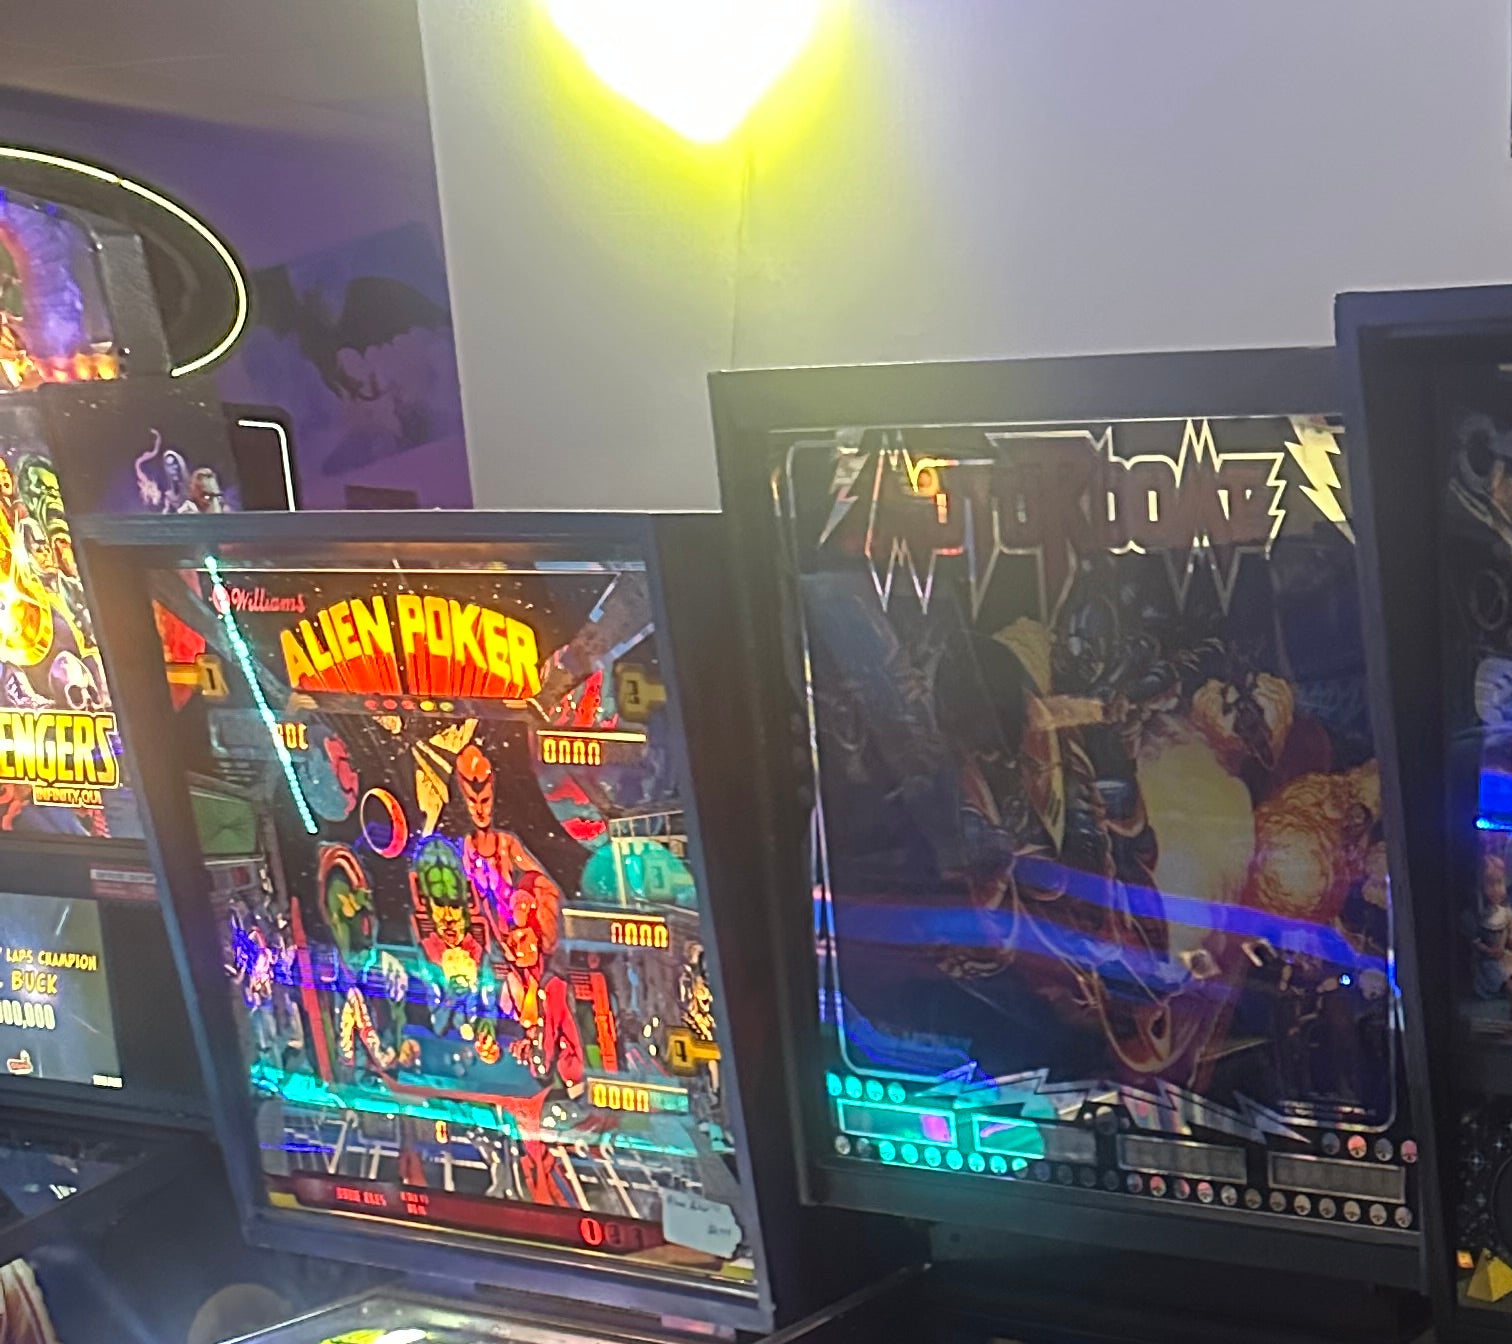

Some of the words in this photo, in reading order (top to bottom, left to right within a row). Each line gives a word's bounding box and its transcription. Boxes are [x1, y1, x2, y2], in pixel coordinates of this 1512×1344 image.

[231, 588, 305, 614] Williams
[281, 595, 395, 690] ALIEN
[397, 594, 541, 698] POKER
[6, 948, 34, 964] LAPS
[38, 950, 98, 971] CHAMPION
[11, 970, 58, 994] BUCK
[0, 999, 56, 1030] 00,000
